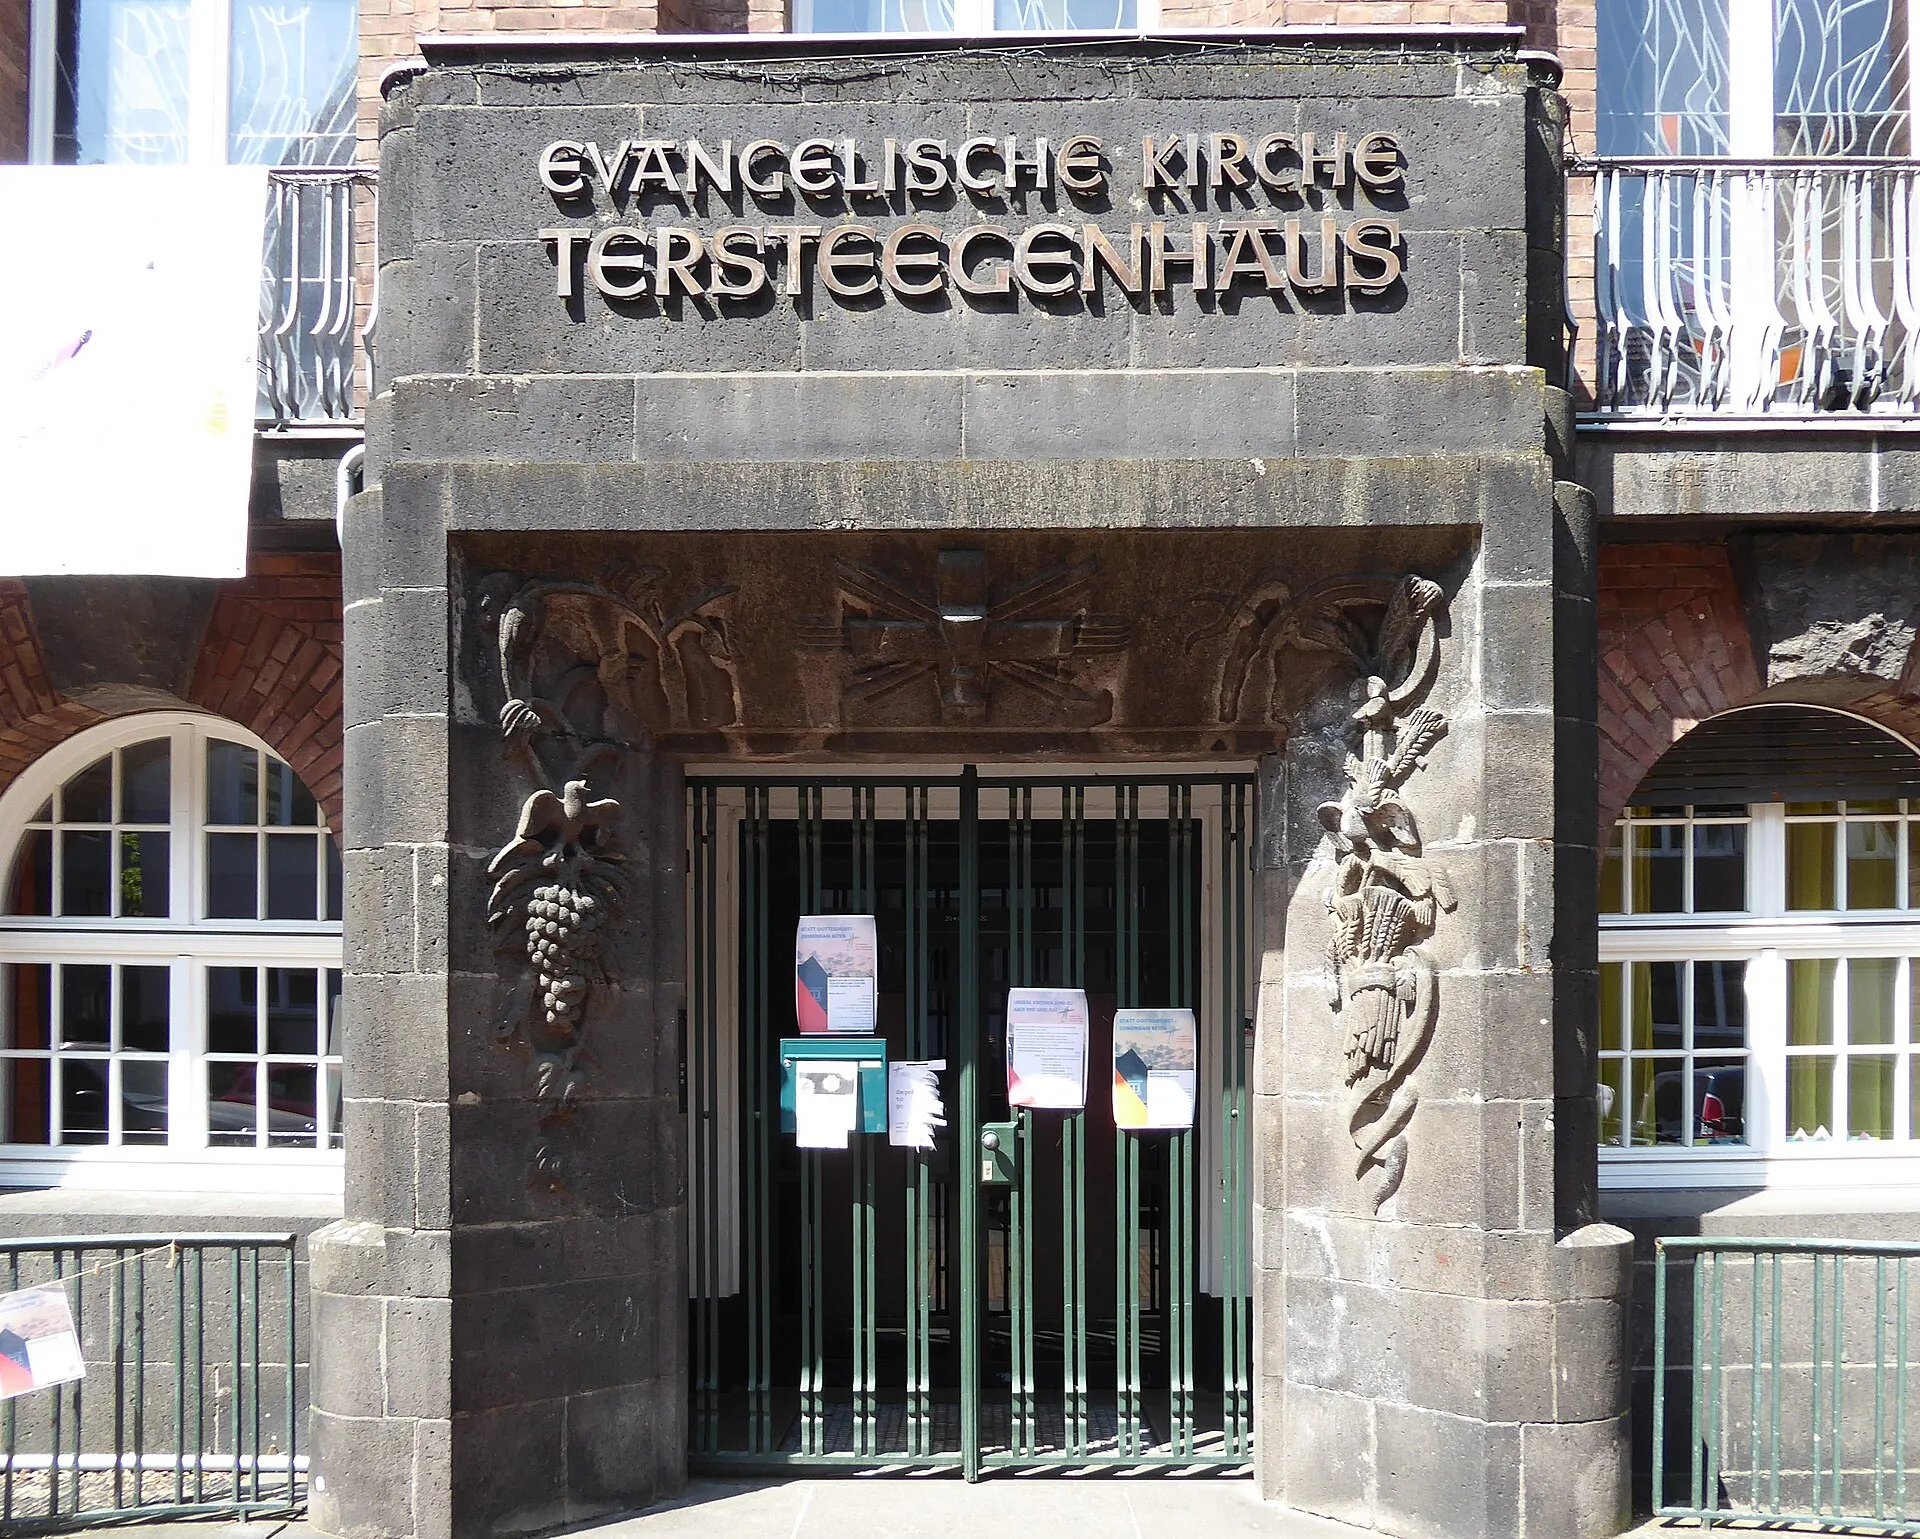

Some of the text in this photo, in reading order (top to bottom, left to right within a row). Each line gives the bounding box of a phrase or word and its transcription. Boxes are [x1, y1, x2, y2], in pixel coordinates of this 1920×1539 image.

[539, 132, 1402, 194] EVANGELISCHE KIRCHE
[538, 218, 1401, 298] TERSTEEGENHAUS
